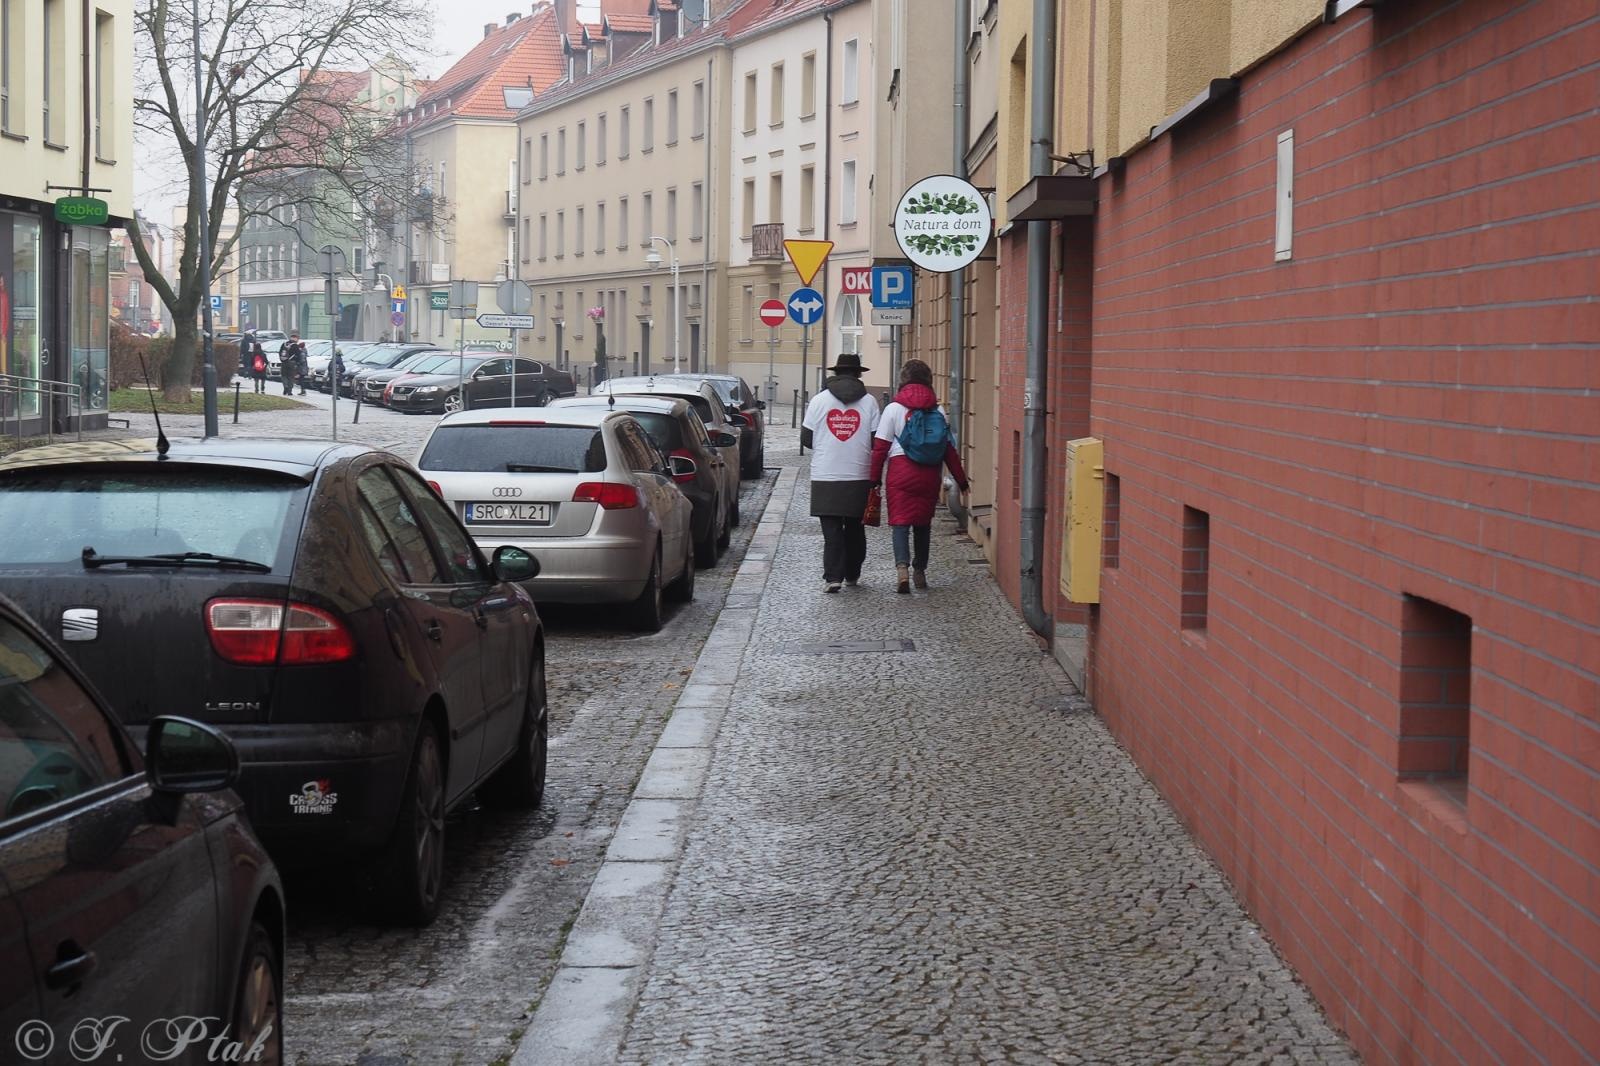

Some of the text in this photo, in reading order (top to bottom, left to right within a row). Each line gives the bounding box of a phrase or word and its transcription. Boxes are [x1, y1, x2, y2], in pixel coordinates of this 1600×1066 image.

[61, 202, 103, 216] żabka
[904, 218, 982, 231] Natura dom
[845, 271, 872, 290] OK
[881, 271, 904, 303] P
[476, 505, 503, 519] SRC
[510, 505, 544, 519] XL21
[206, 702, 260, 711] LEON
